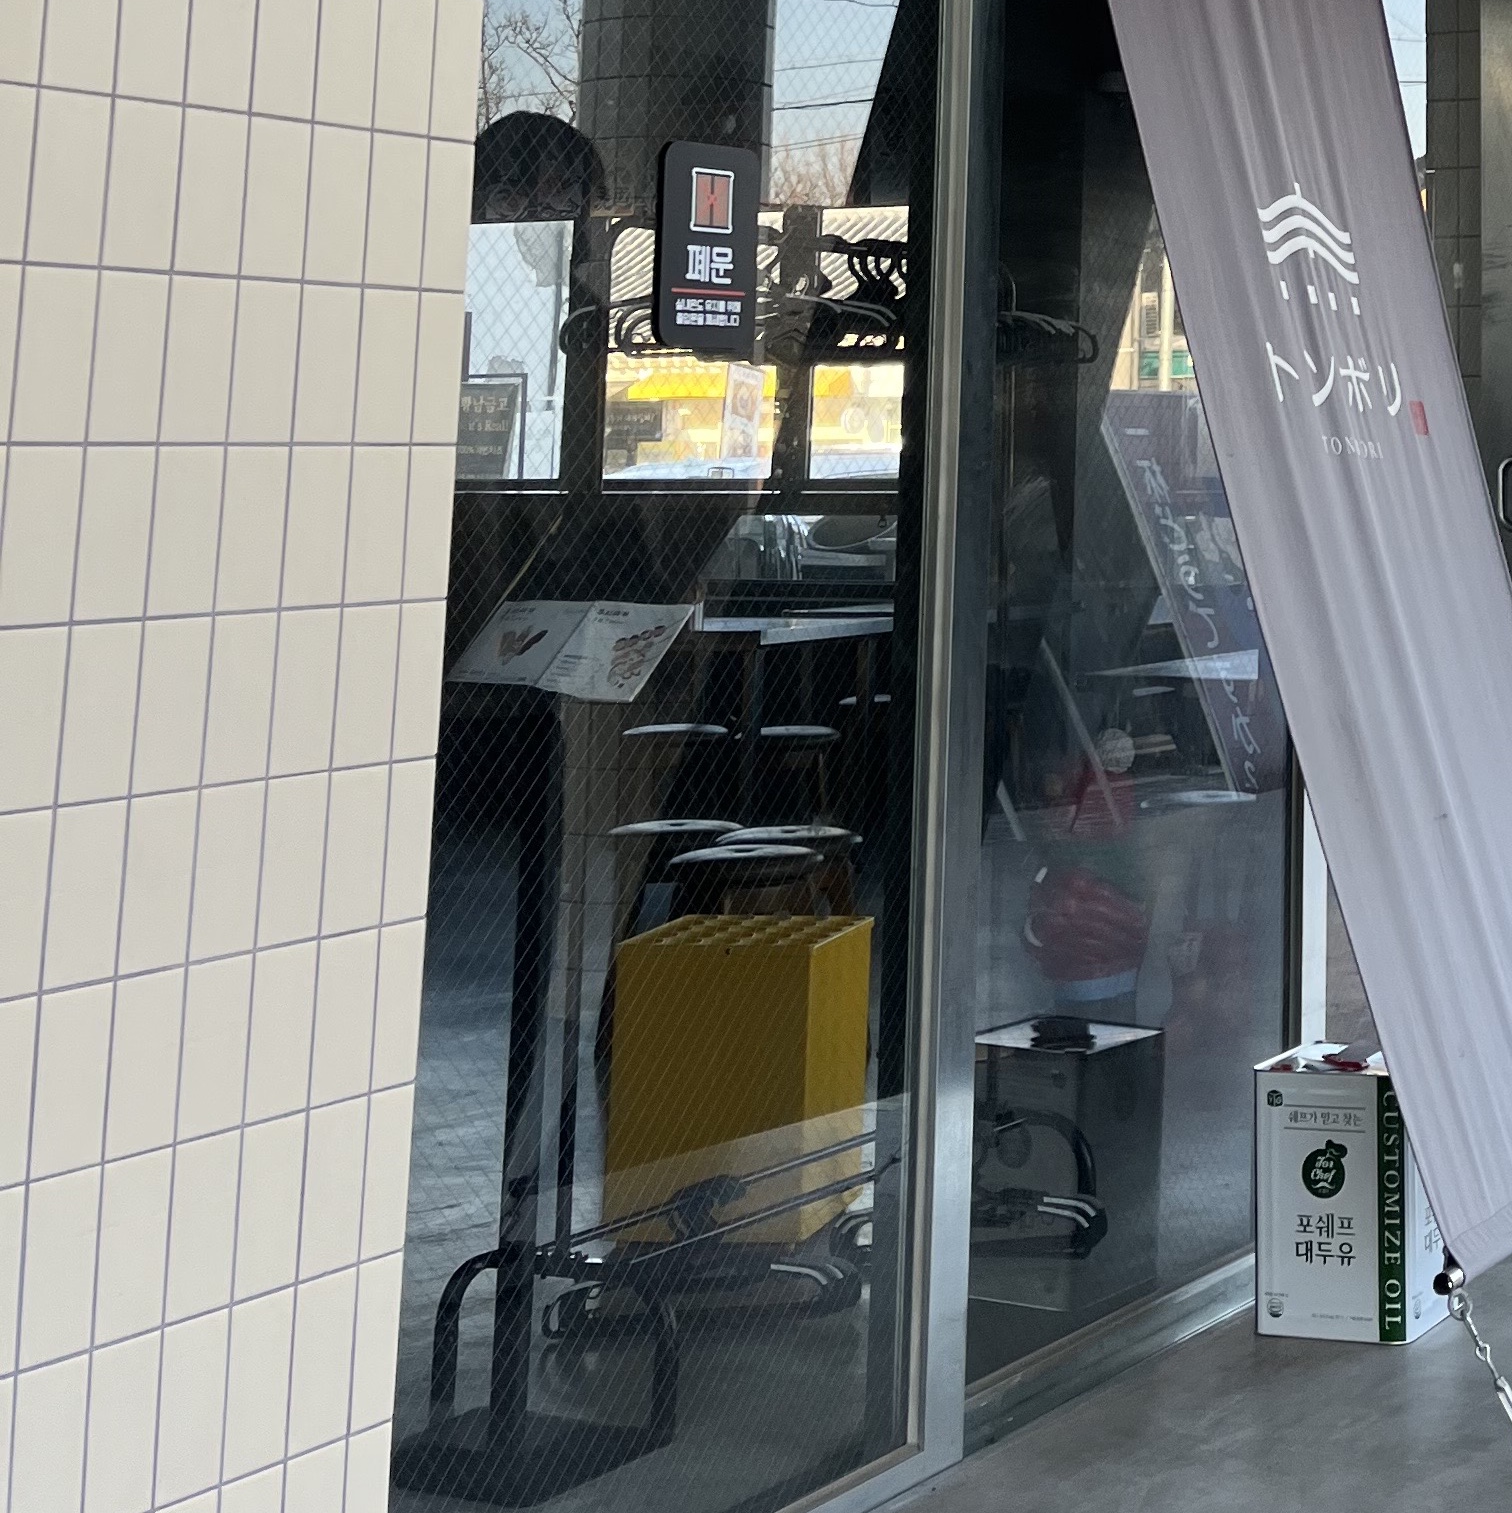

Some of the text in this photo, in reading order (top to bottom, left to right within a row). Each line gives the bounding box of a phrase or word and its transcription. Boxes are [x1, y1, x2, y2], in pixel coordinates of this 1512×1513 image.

[1265, 341, 1402, 416] トンボリ
[1310, 1168, 1337, 1183] Chef
[1382, 1090, 1401, 1332] CUSTOMIZE OIL
[1296, 1214, 1356, 1239] 포쉐프
[1295, 1241, 1356, 1267] 대두유
